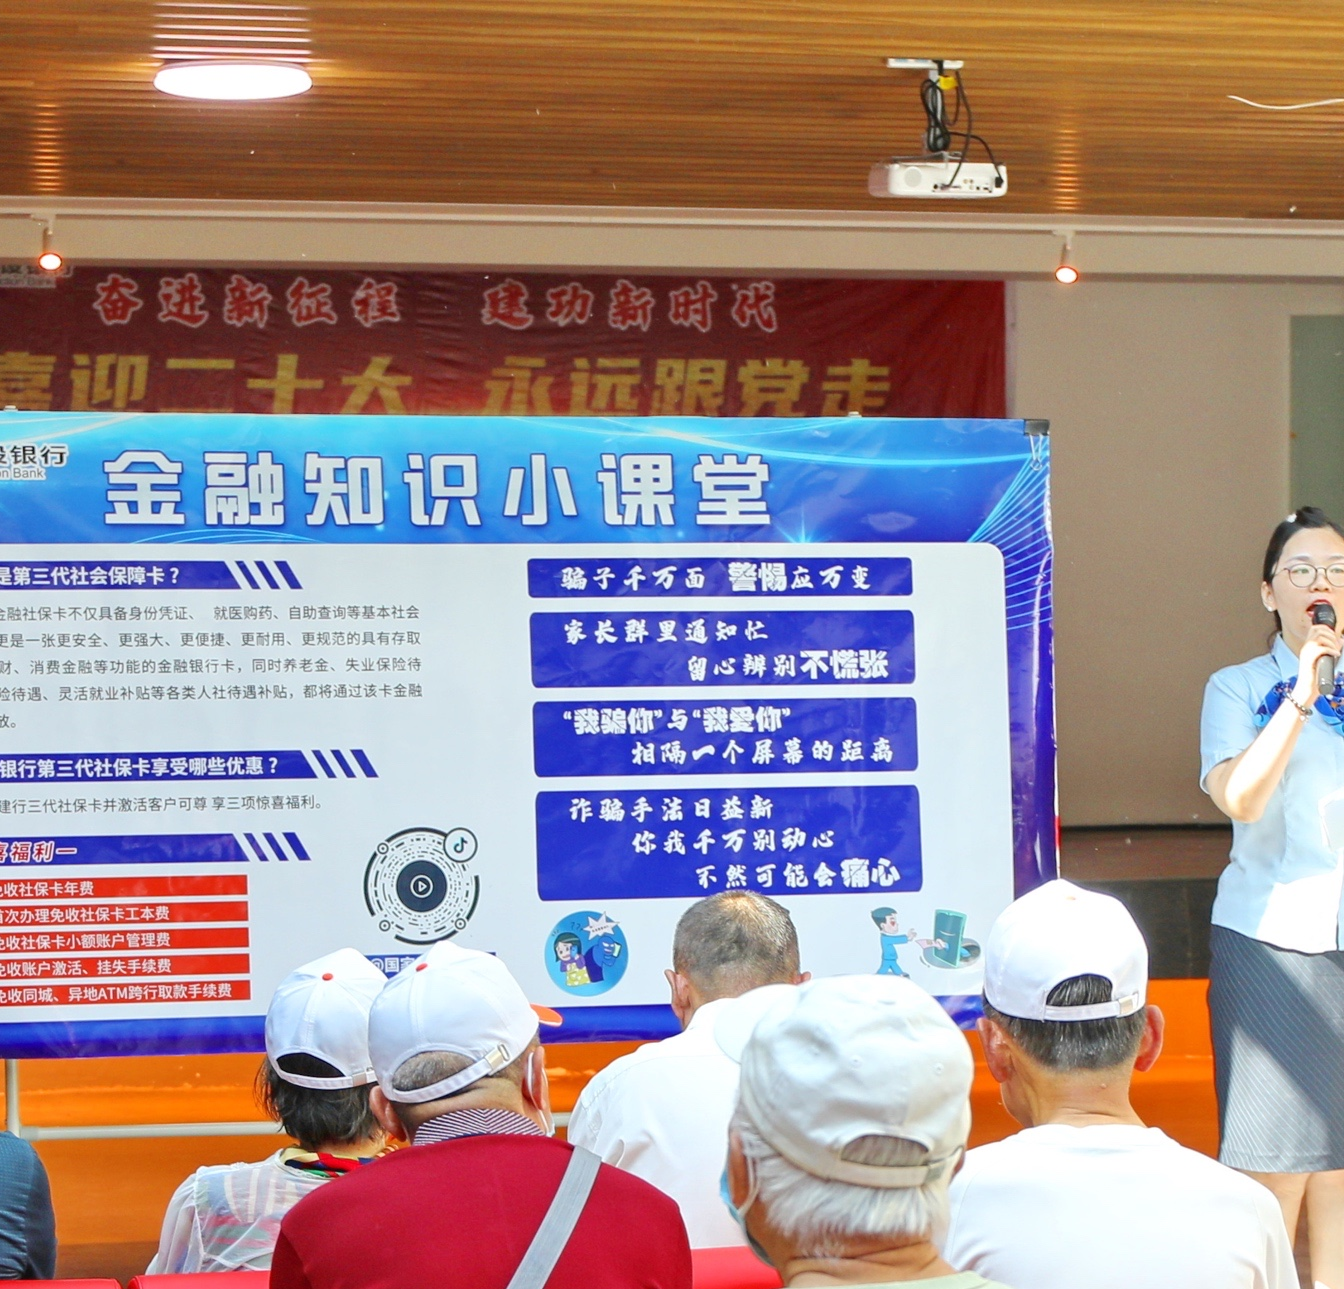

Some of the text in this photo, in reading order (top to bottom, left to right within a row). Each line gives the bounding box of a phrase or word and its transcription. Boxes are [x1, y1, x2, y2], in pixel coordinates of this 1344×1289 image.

[93, 273, 777, 333] 奋进新征程 建功新时代
[482, 356, 891, 416] 永远跟党走
[13, 467, 44, 478] Bank
[103, 449, 772, 526] 金融知识小课堂
[563, 618, 769, 645] 家长群里通知忙
[687, 649, 889, 682] 留心辨别不慌张
[631, 737, 894, 766] 相隔一个屏幕的距离
[569, 794, 774, 823] 诈骗手法日益新
[631, 827, 835, 855] 你我千万别动心
[695, 857, 901, 889] 不然可能会痛心
